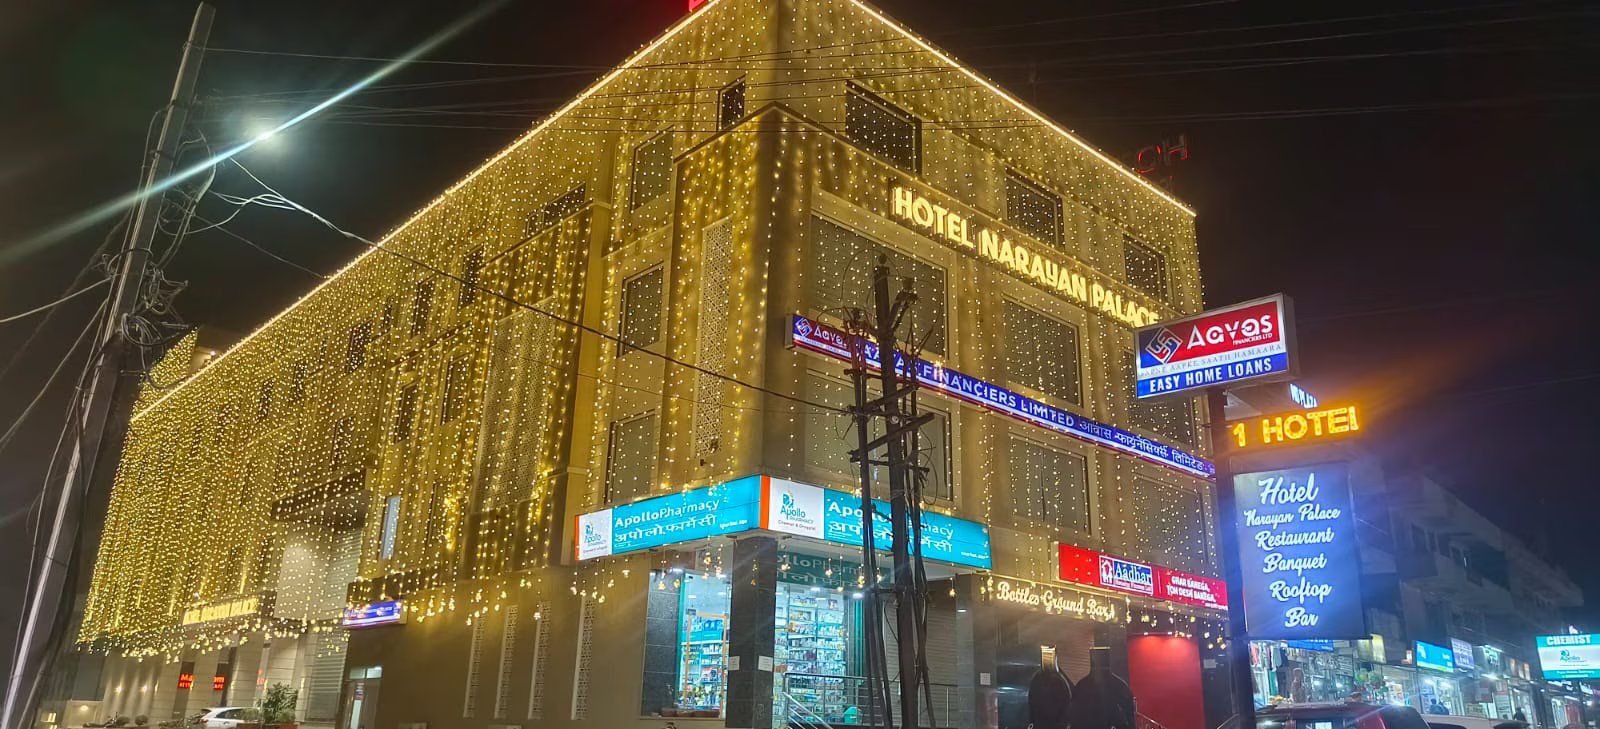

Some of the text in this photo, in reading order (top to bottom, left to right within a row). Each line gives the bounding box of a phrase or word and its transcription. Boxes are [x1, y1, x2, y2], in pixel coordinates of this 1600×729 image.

[893, 187, 1161, 328] HOTEL NARAYAN PALACE
[1186, 314, 1273, 350] Aavas
[1233, 335, 1262, 346] FINANCIERS
[1150, 358, 1272, 392] EASY HOME LOANS
[923, 364, 1016, 408] FINANCIERS
[1020, 399, 1074, 427] LIMITED
[1080, 421, 1112, 439] आवास
[1259, 473, 1319, 505] Hotel
[614, 500, 720, 529] ApolloPharmacy
[780, 505, 806, 520] Apollo
[1244, 503, 1341, 529] Narayan Palace
[1255, 527, 1335, 551] Restaurant
[1114, 562, 1152, 585] Aadhar
[1263, 553, 1327, 576] Banquet
[996, 582, 1039, 606] Bottles
[1042, 589, 1084, 615] Ground
[1270, 576, 1332, 604] Rooftop
[1285, 607, 1319, 628] Bar
[1546, 634, 1591, 646] CHEMIST
